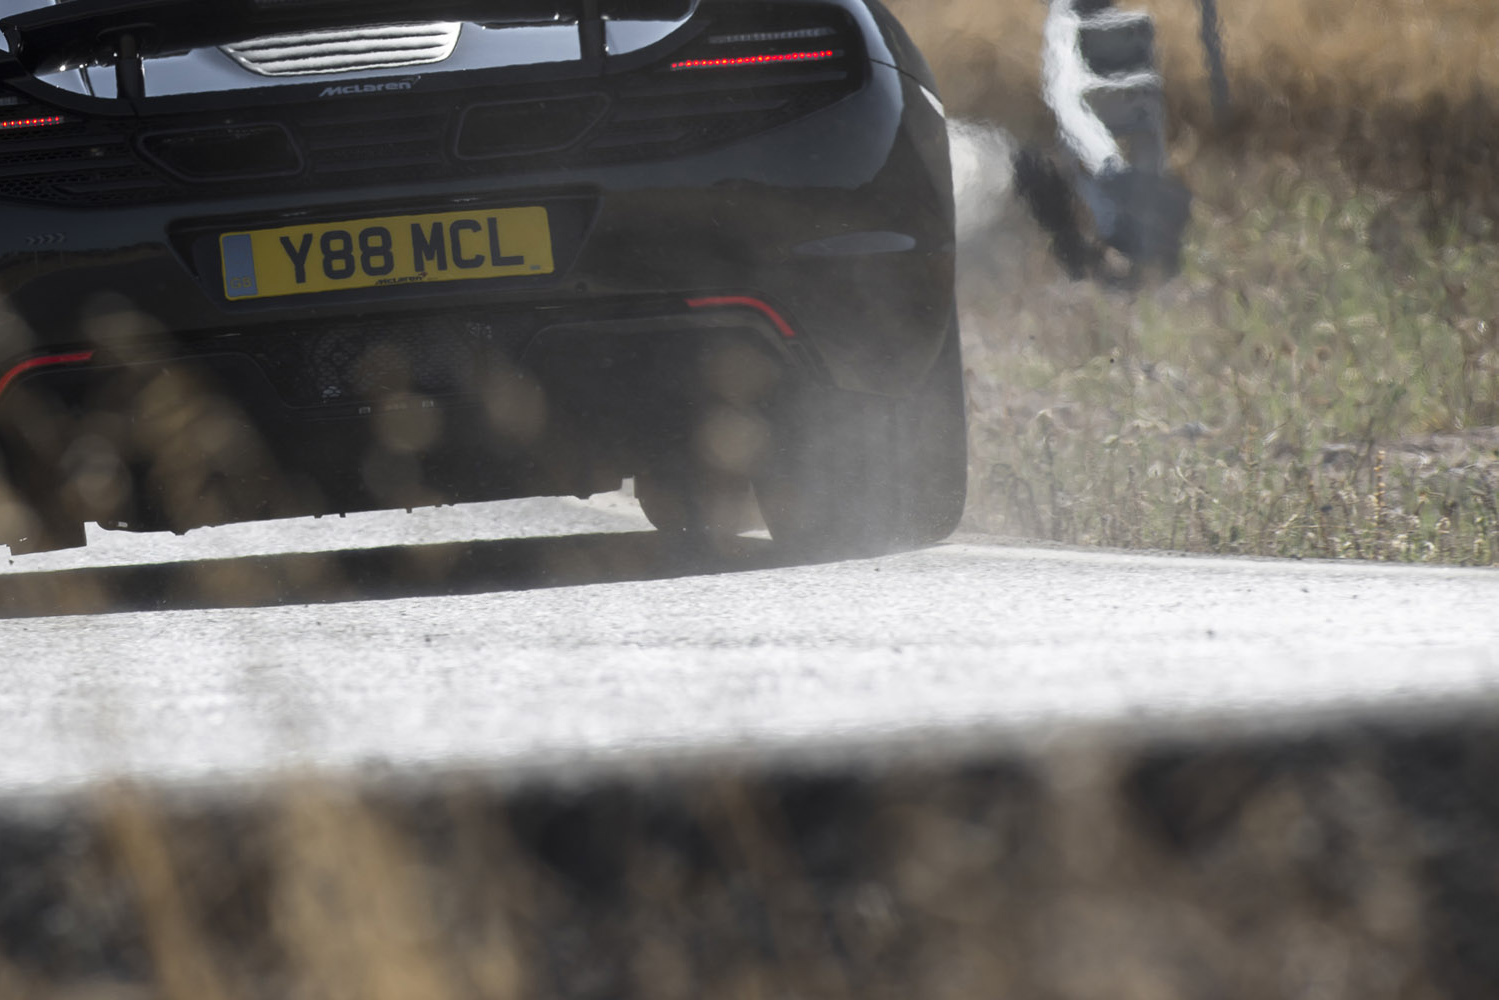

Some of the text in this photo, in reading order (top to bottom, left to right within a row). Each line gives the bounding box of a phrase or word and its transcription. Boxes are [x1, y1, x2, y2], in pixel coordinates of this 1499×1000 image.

[318, 81, 412, 97] McLaren
[279, 217, 524, 284] Y88 MCL
[230, 276, 252, 289] GB
